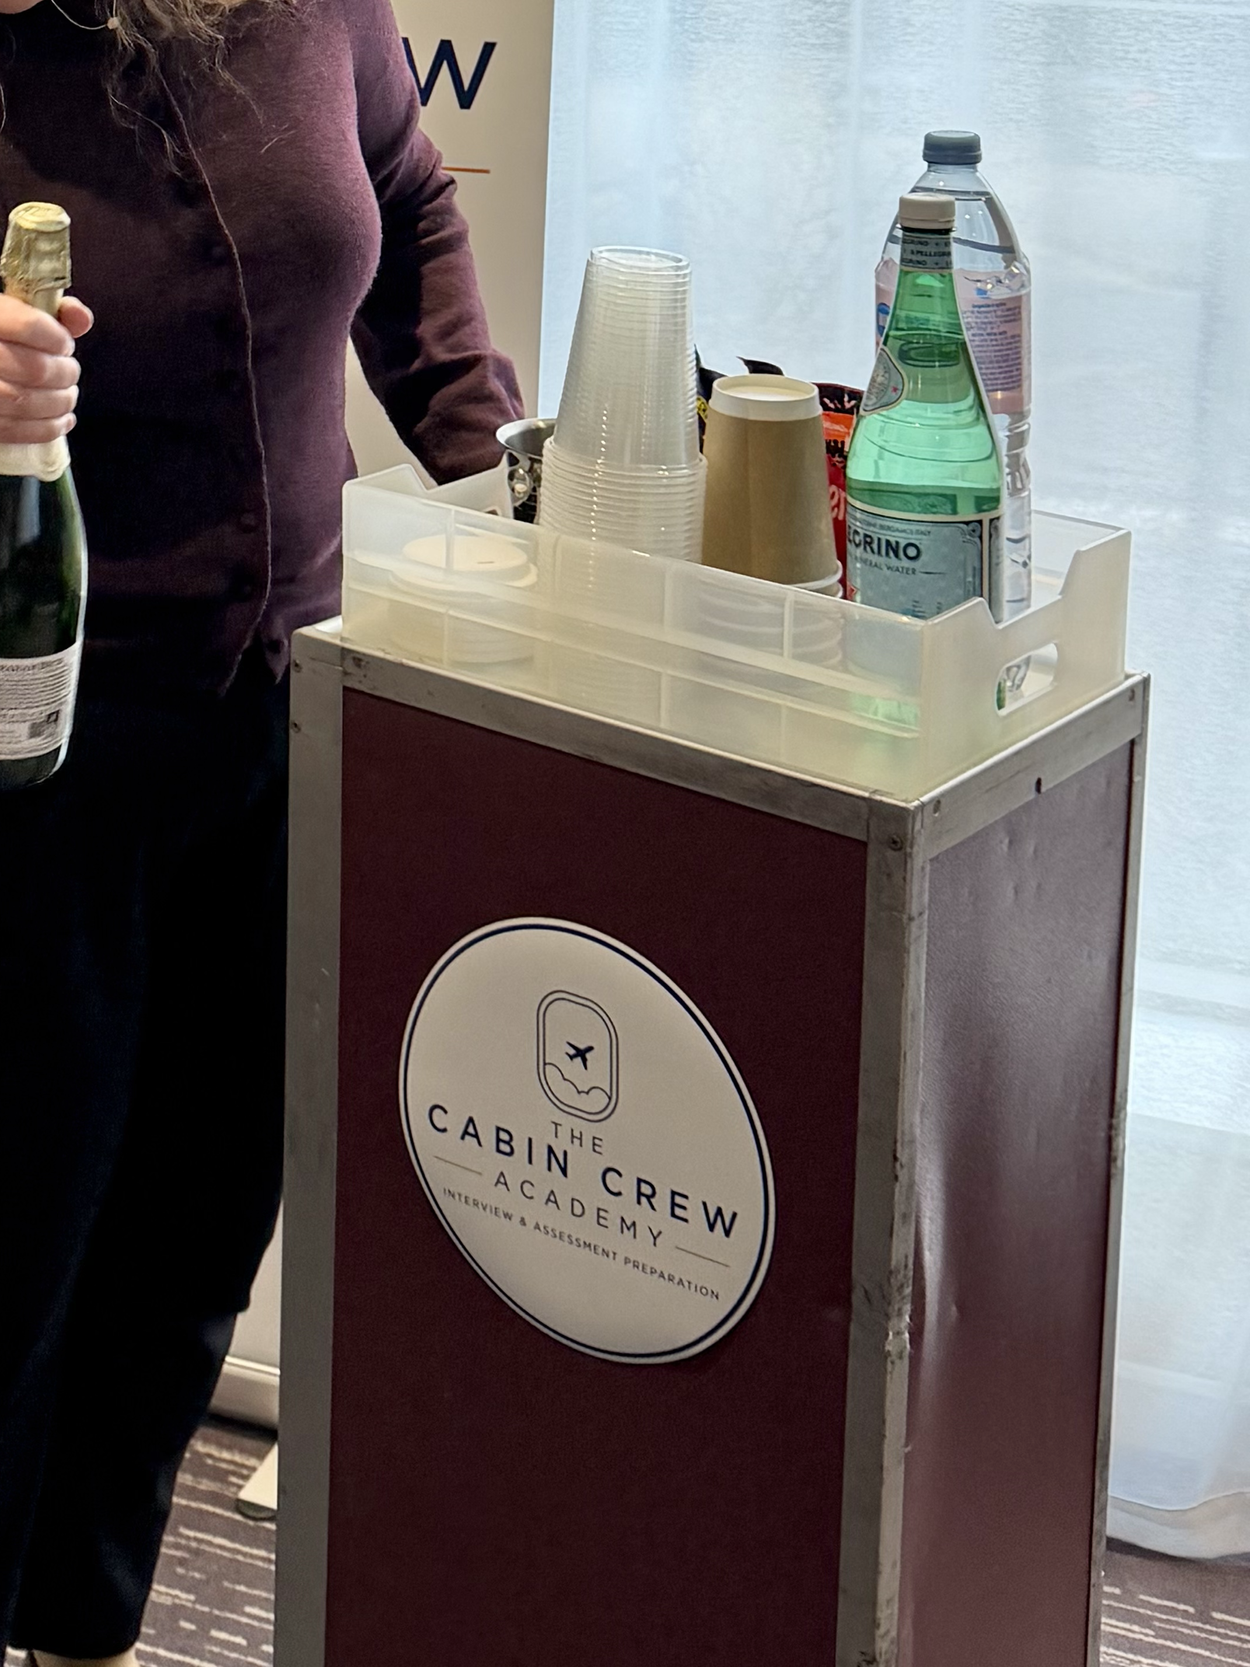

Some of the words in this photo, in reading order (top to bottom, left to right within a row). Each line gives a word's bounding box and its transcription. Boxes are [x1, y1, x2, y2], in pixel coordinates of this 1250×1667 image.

[885, 563, 917, 575] WATER
[428, 1104, 568, 1179] CABIN
[601, 1166, 738, 1239] CREW
[550, 1120, 603, 1156] THE
[442, 1187, 514, 1222] INTERVIEW
[519, 1216, 527, 1227] &
[533, 1221, 618, 1261] ASSESSMENT
[623, 1256, 720, 1301] PREPARATION
[494, 1170, 663, 1248] ACADEMY
